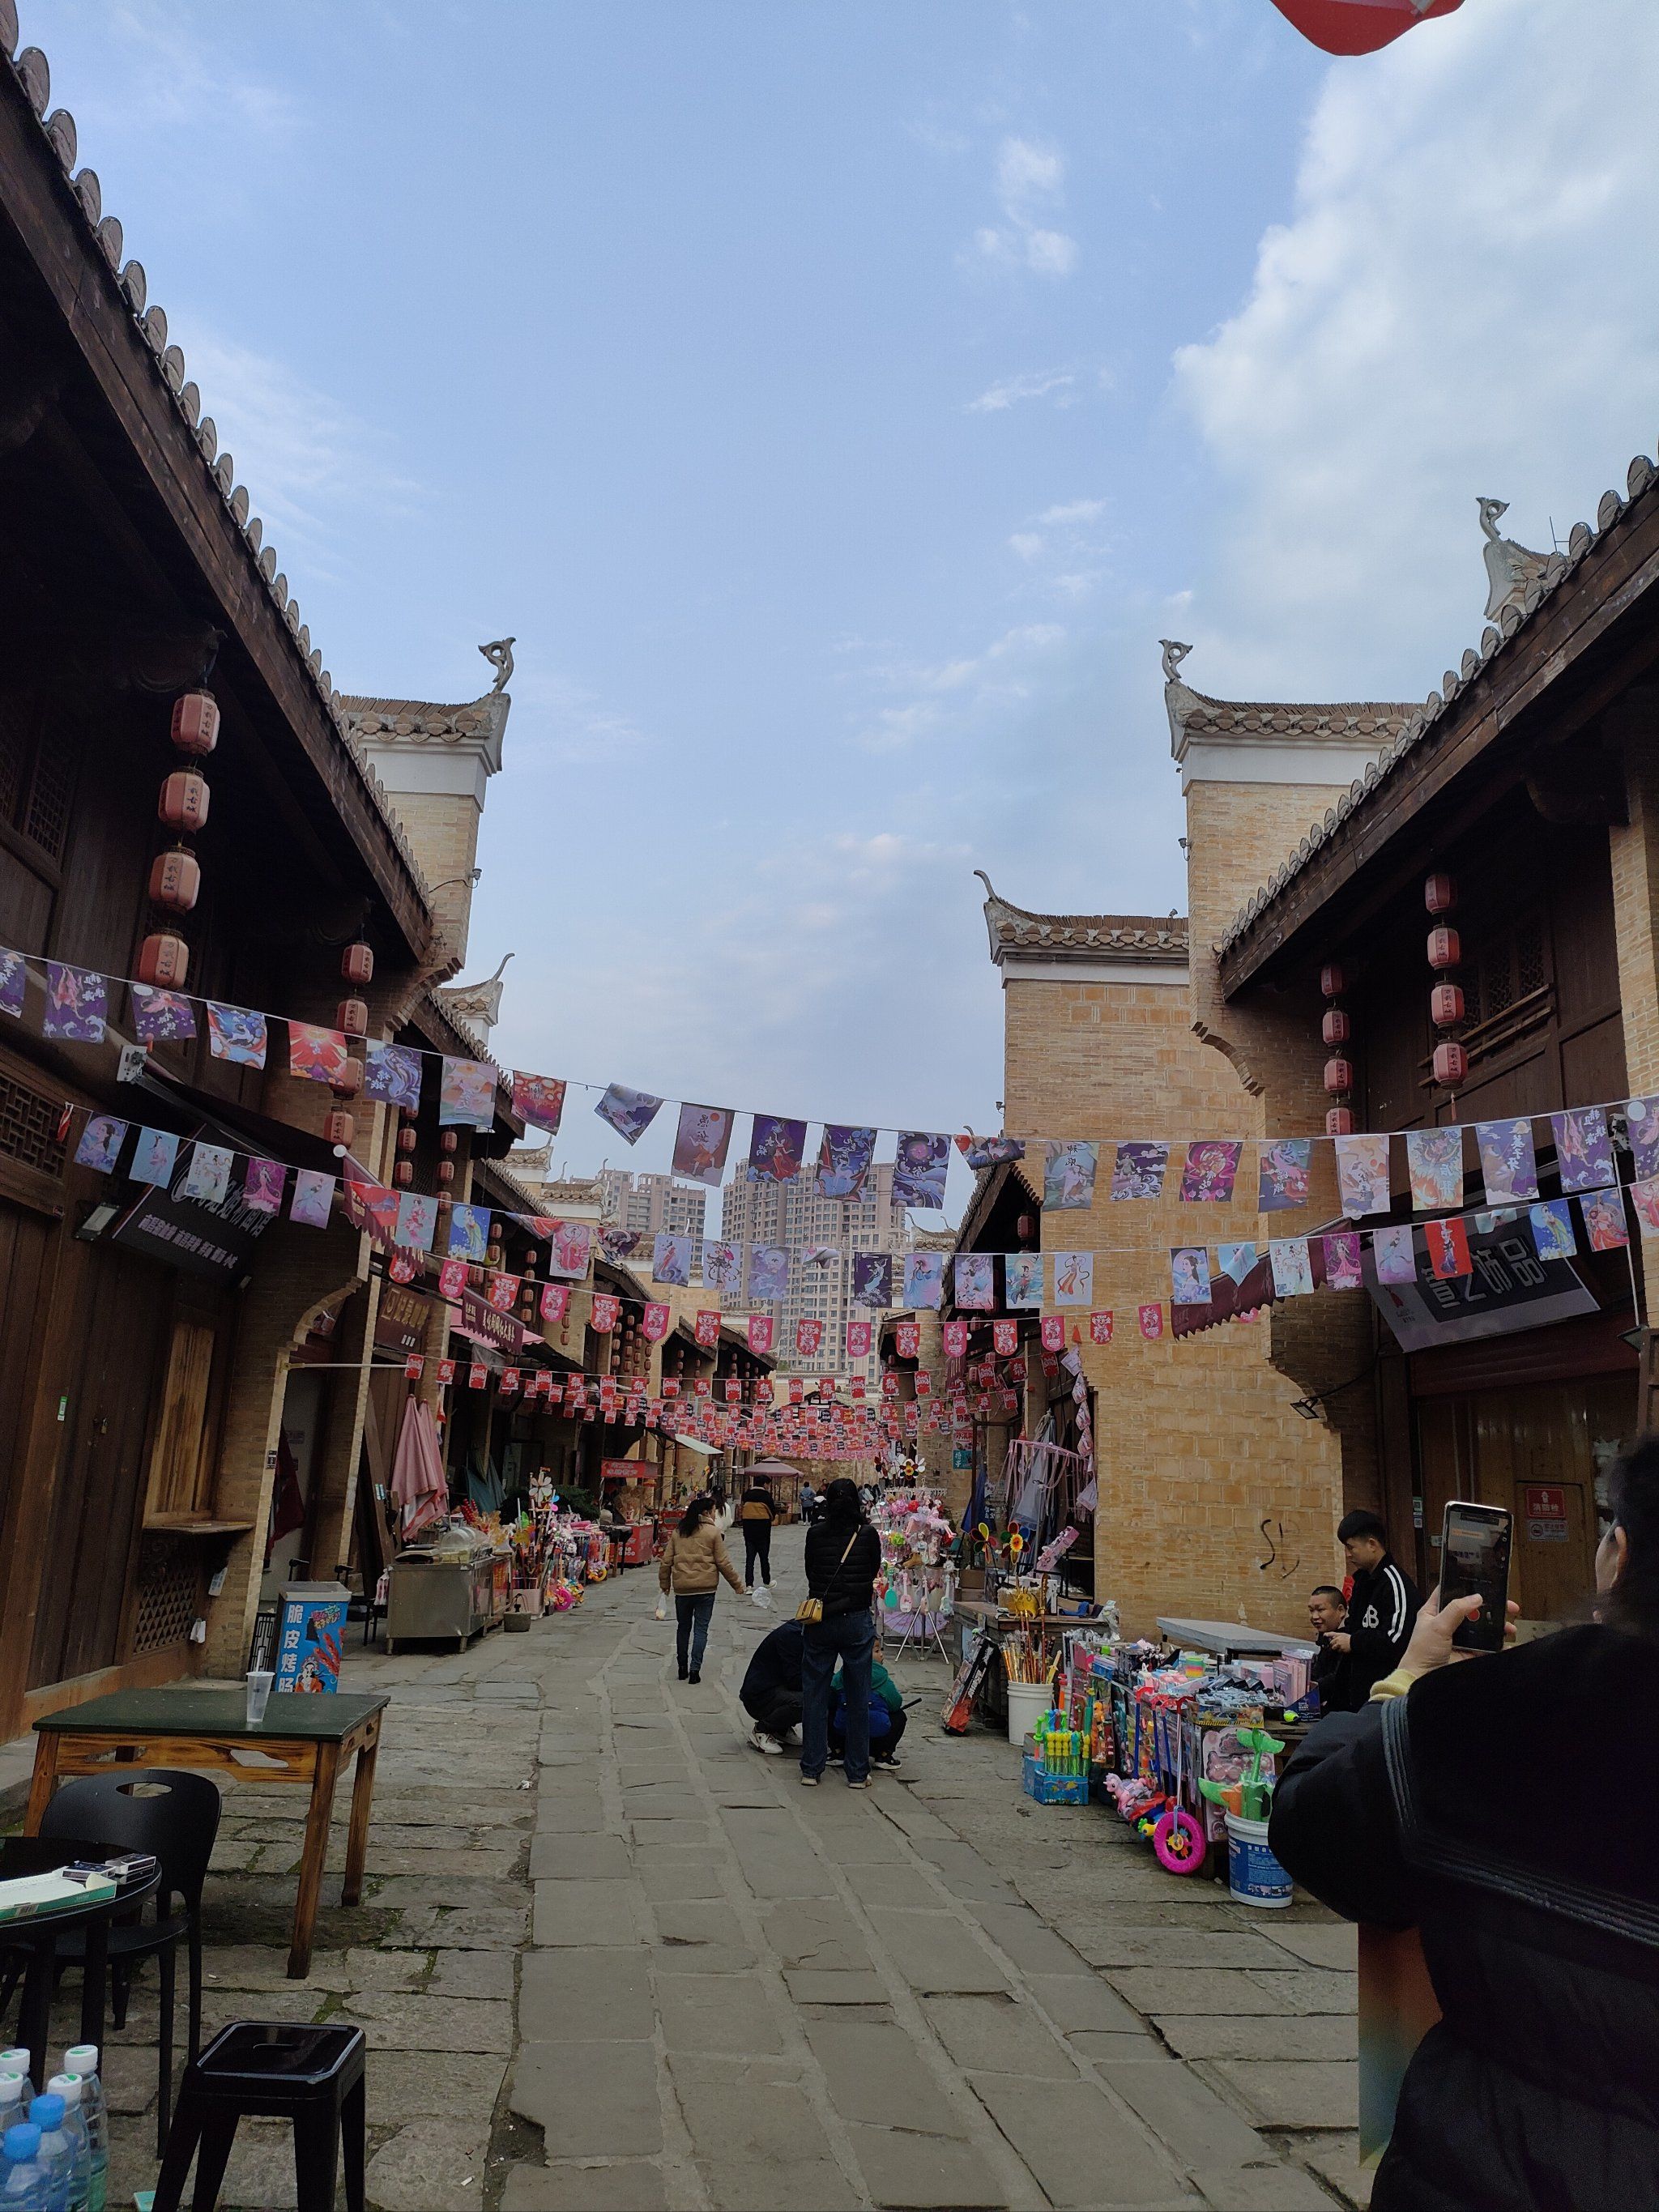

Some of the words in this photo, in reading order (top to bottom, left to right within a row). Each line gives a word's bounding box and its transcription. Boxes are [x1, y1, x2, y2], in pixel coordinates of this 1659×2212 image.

[164, 856, 178, 892] 万载古城
[1444, 988, 1453, 1014] 万载古城
[1450, 1046, 1459, 1073] 万载古城
[1507, 1134, 1525, 1171] 姜子牙
[278, 1605, 304, 1693] 脆皮烤肠
